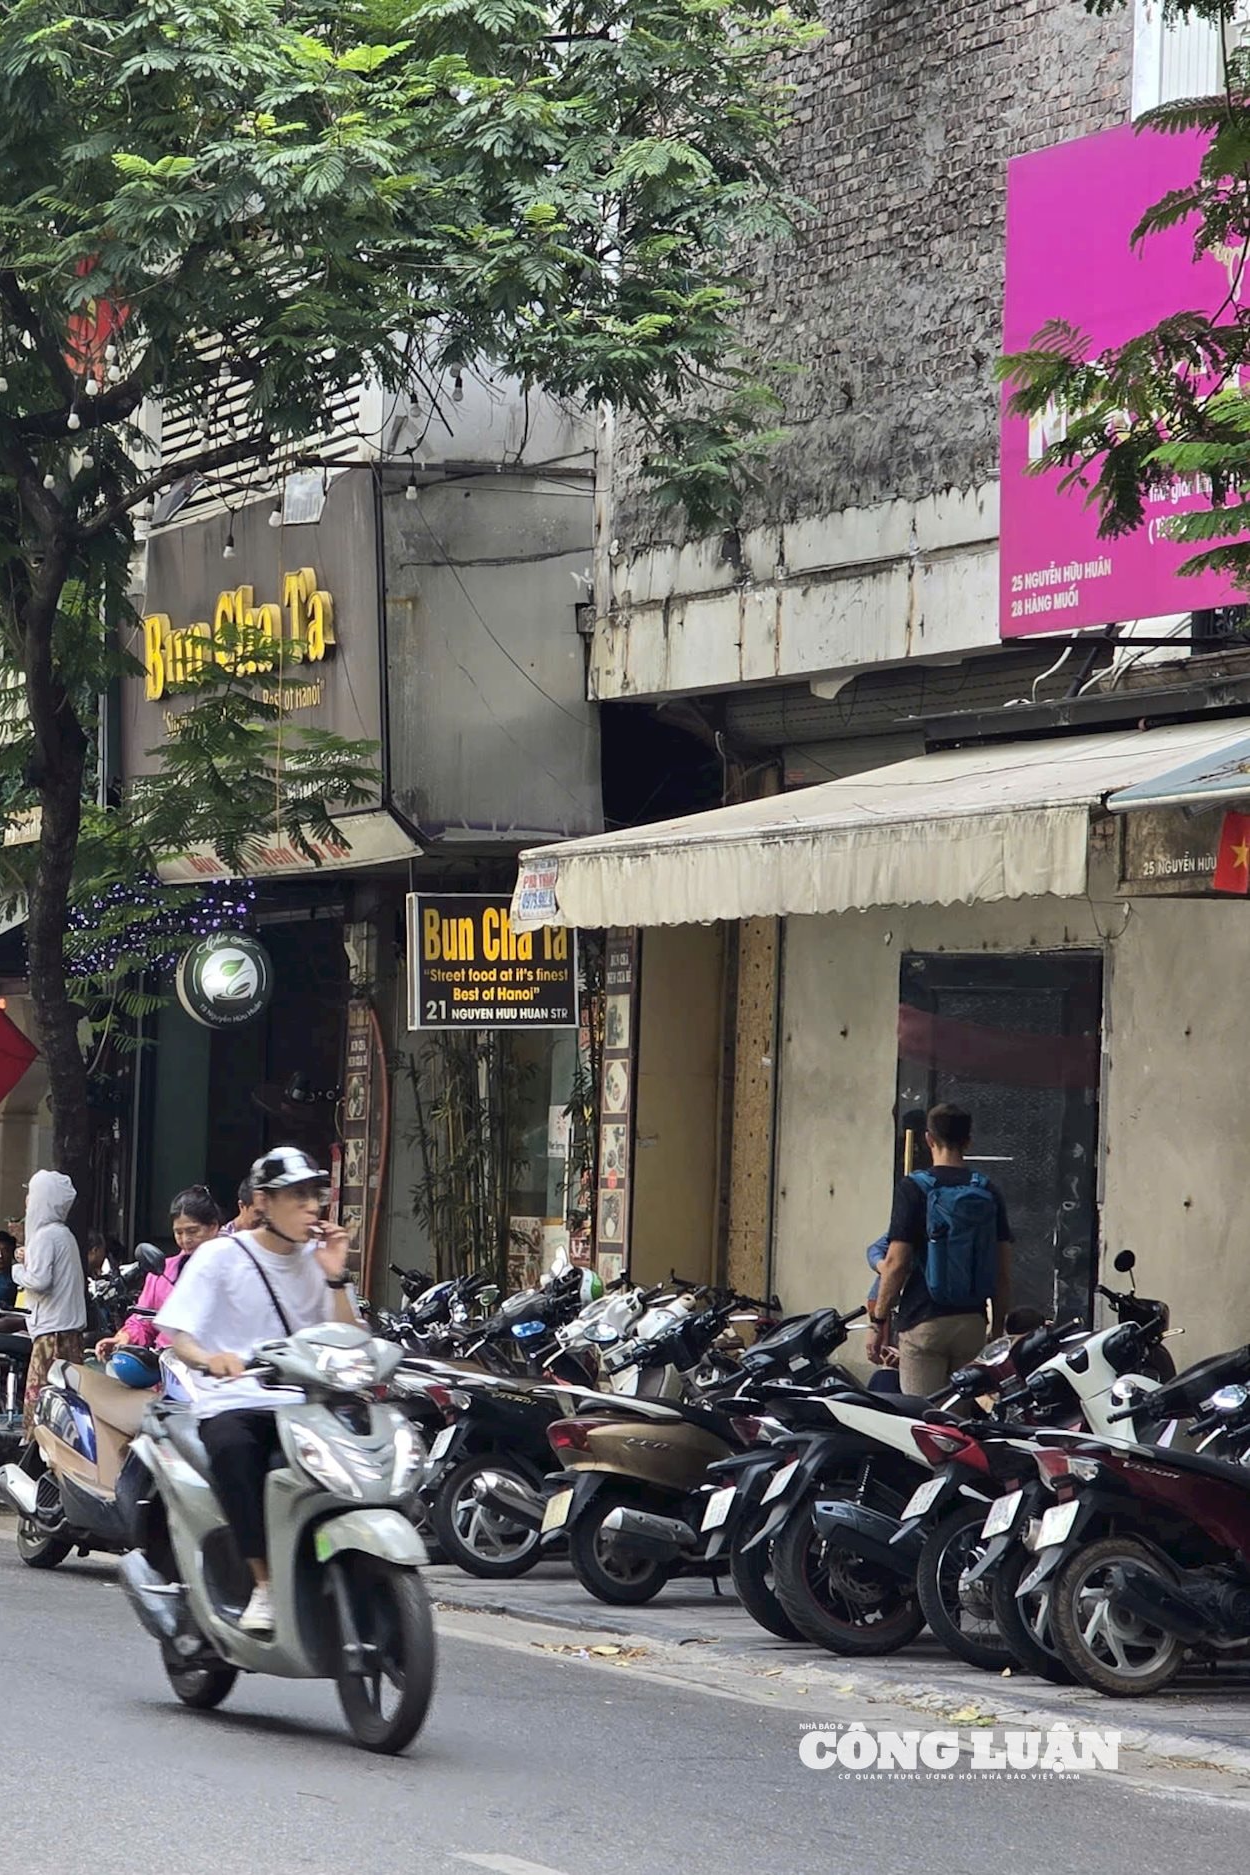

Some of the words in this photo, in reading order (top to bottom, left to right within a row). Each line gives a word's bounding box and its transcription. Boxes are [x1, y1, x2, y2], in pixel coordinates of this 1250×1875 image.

[1012, 575, 1023, 592] 25
[1024, 561, 1062, 589] NGUYỄN
[1063, 561, 1083, 583] HỮU
[1011, 600, 1023, 617] 28
[1024, 592, 1052, 615] HÀNG
[1053, 583, 1079, 609] MUỐI
[283, 567, 336, 662] Ta
[1143, 861, 1156, 876] 25
[1158, 851, 1196, 875] NGUYỄN
[424, 908, 475, 961] Bun
[482, 907, 533, 961] Cha
[468, 968, 497, 982] food
[499, 968, 513, 982] at
[536, 968, 568, 982] finest
[453, 987, 480, 1001] Best
[482, 987, 495, 1001] of
[426, 1000, 447, 1020] 21
[451, 1008, 494, 1019] NGUYEN
[496, 1008, 518, 1019] HUU
[519, 1008, 549, 1019] HUAN
[550, 1008, 568, 1019] STR
